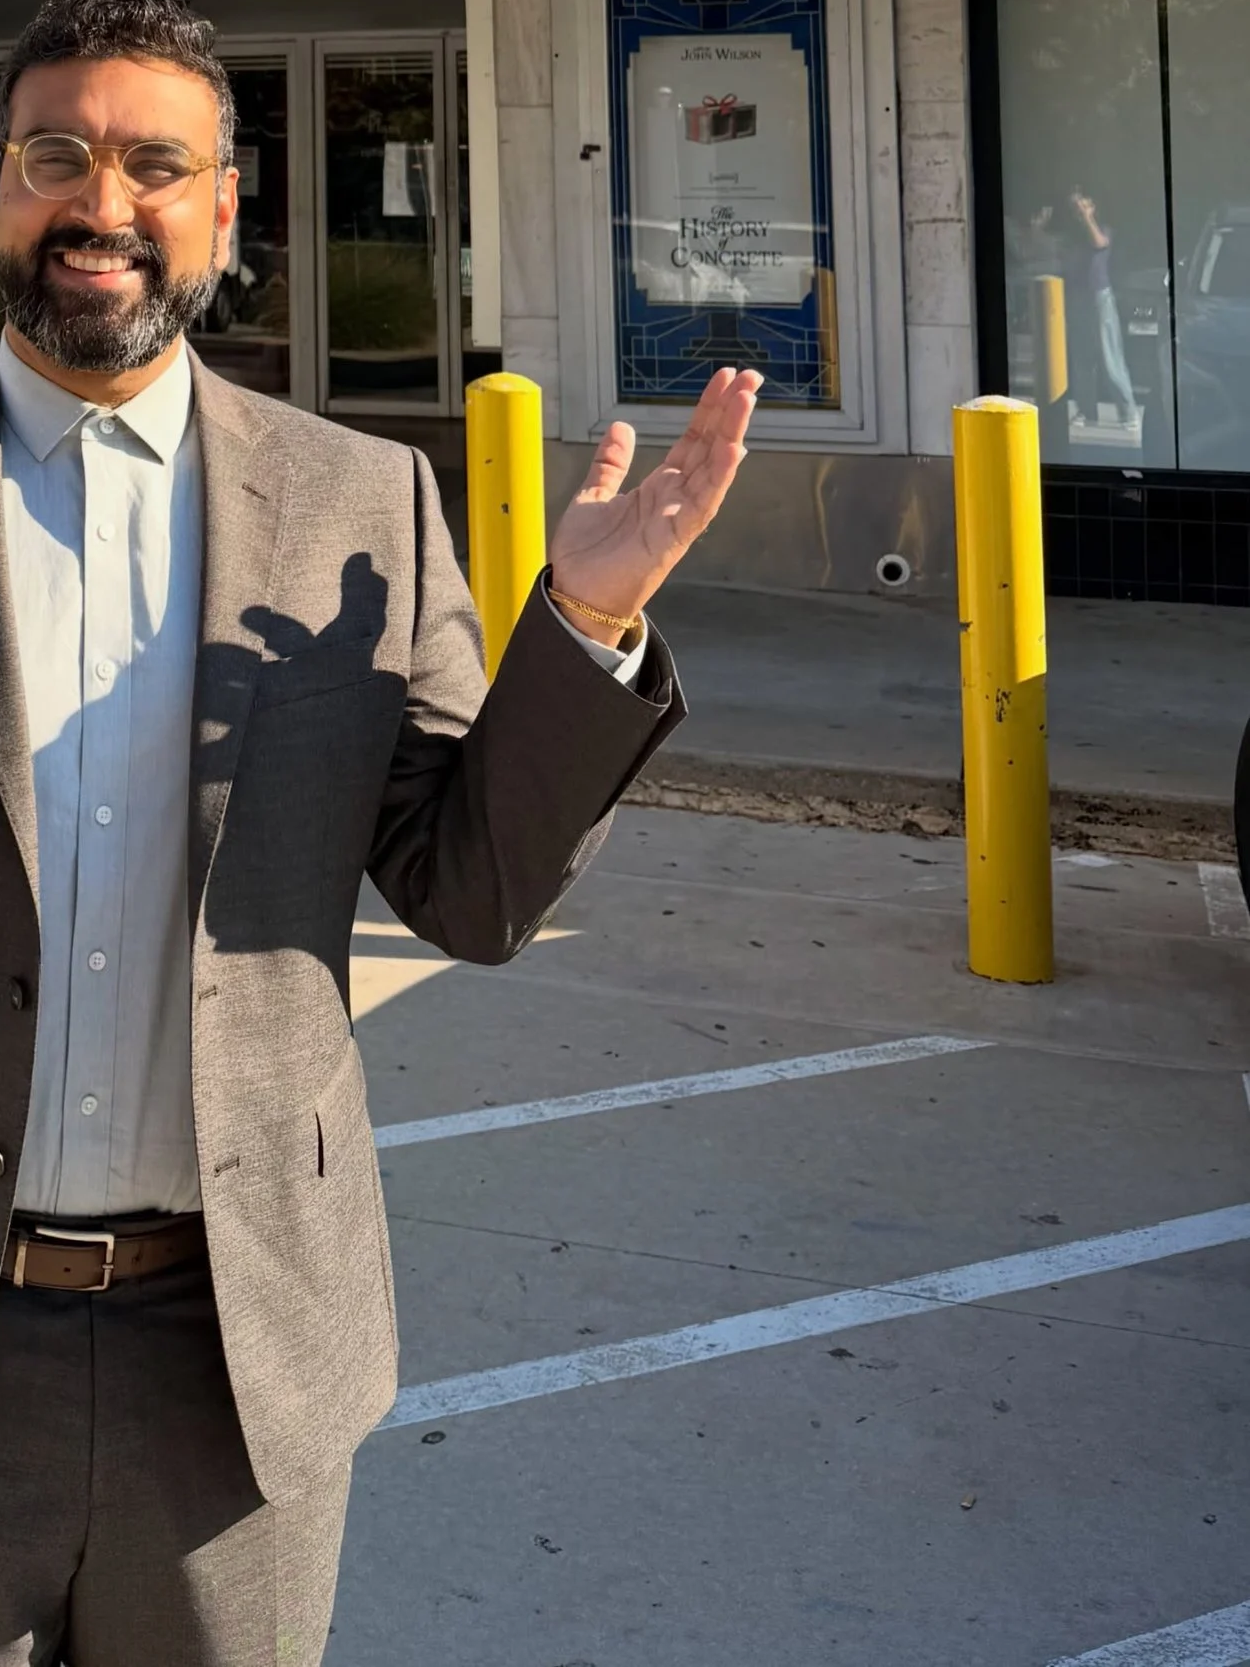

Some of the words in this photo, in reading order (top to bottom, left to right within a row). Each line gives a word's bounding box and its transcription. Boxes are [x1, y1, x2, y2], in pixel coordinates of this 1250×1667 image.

[710, 205, 736, 221] The
[679, 217, 771, 240] HISTORY
[670, 246, 785, 269] CONCRETE
